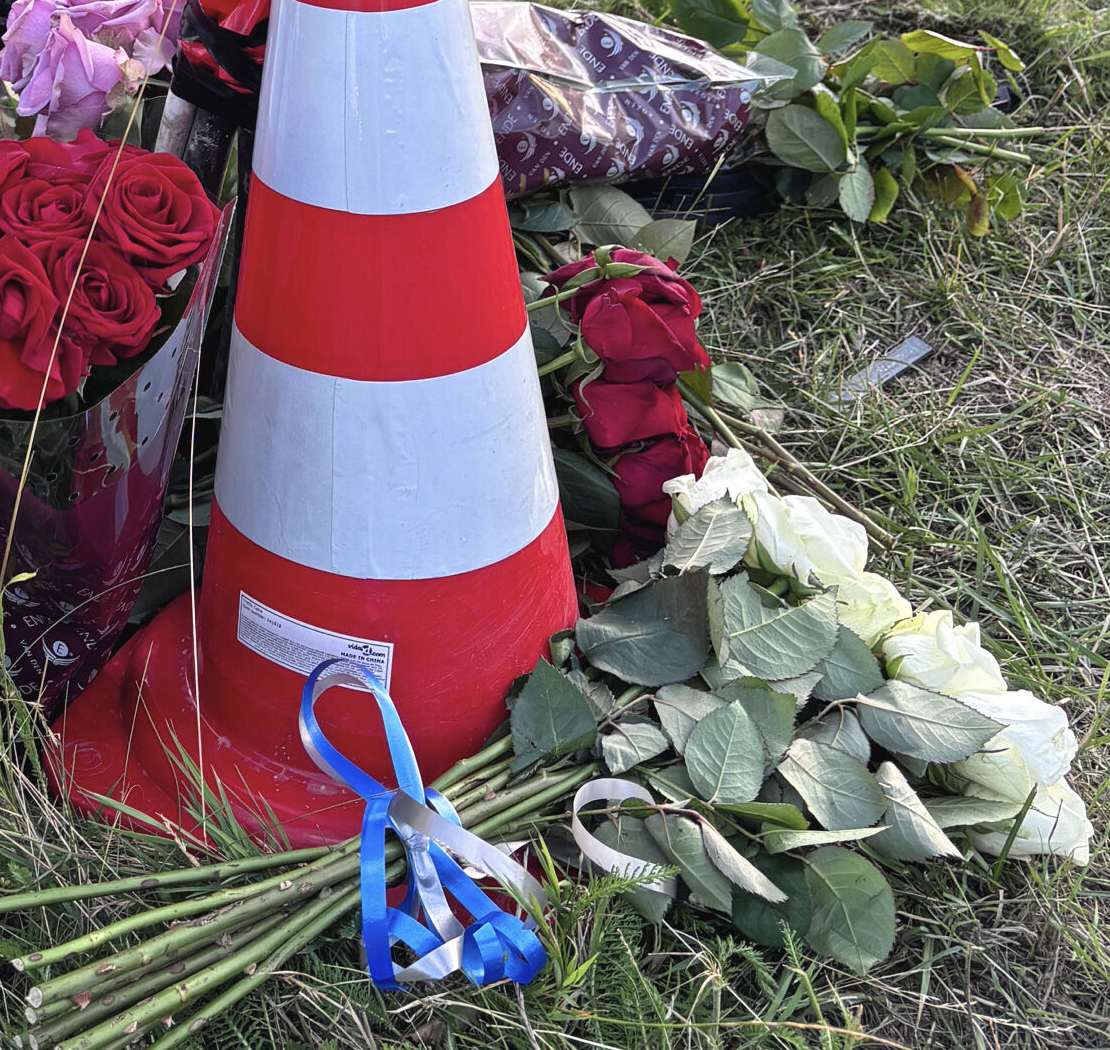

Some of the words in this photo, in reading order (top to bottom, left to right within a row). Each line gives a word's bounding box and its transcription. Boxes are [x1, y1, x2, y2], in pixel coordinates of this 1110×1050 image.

[579, 45, 606, 73] ENDE
[723, 109, 744, 132] ENDE
[669, 124, 695, 150] ENDE
[559, 146, 584, 175] ENDE
[366, 656, 385, 664] CHINA
